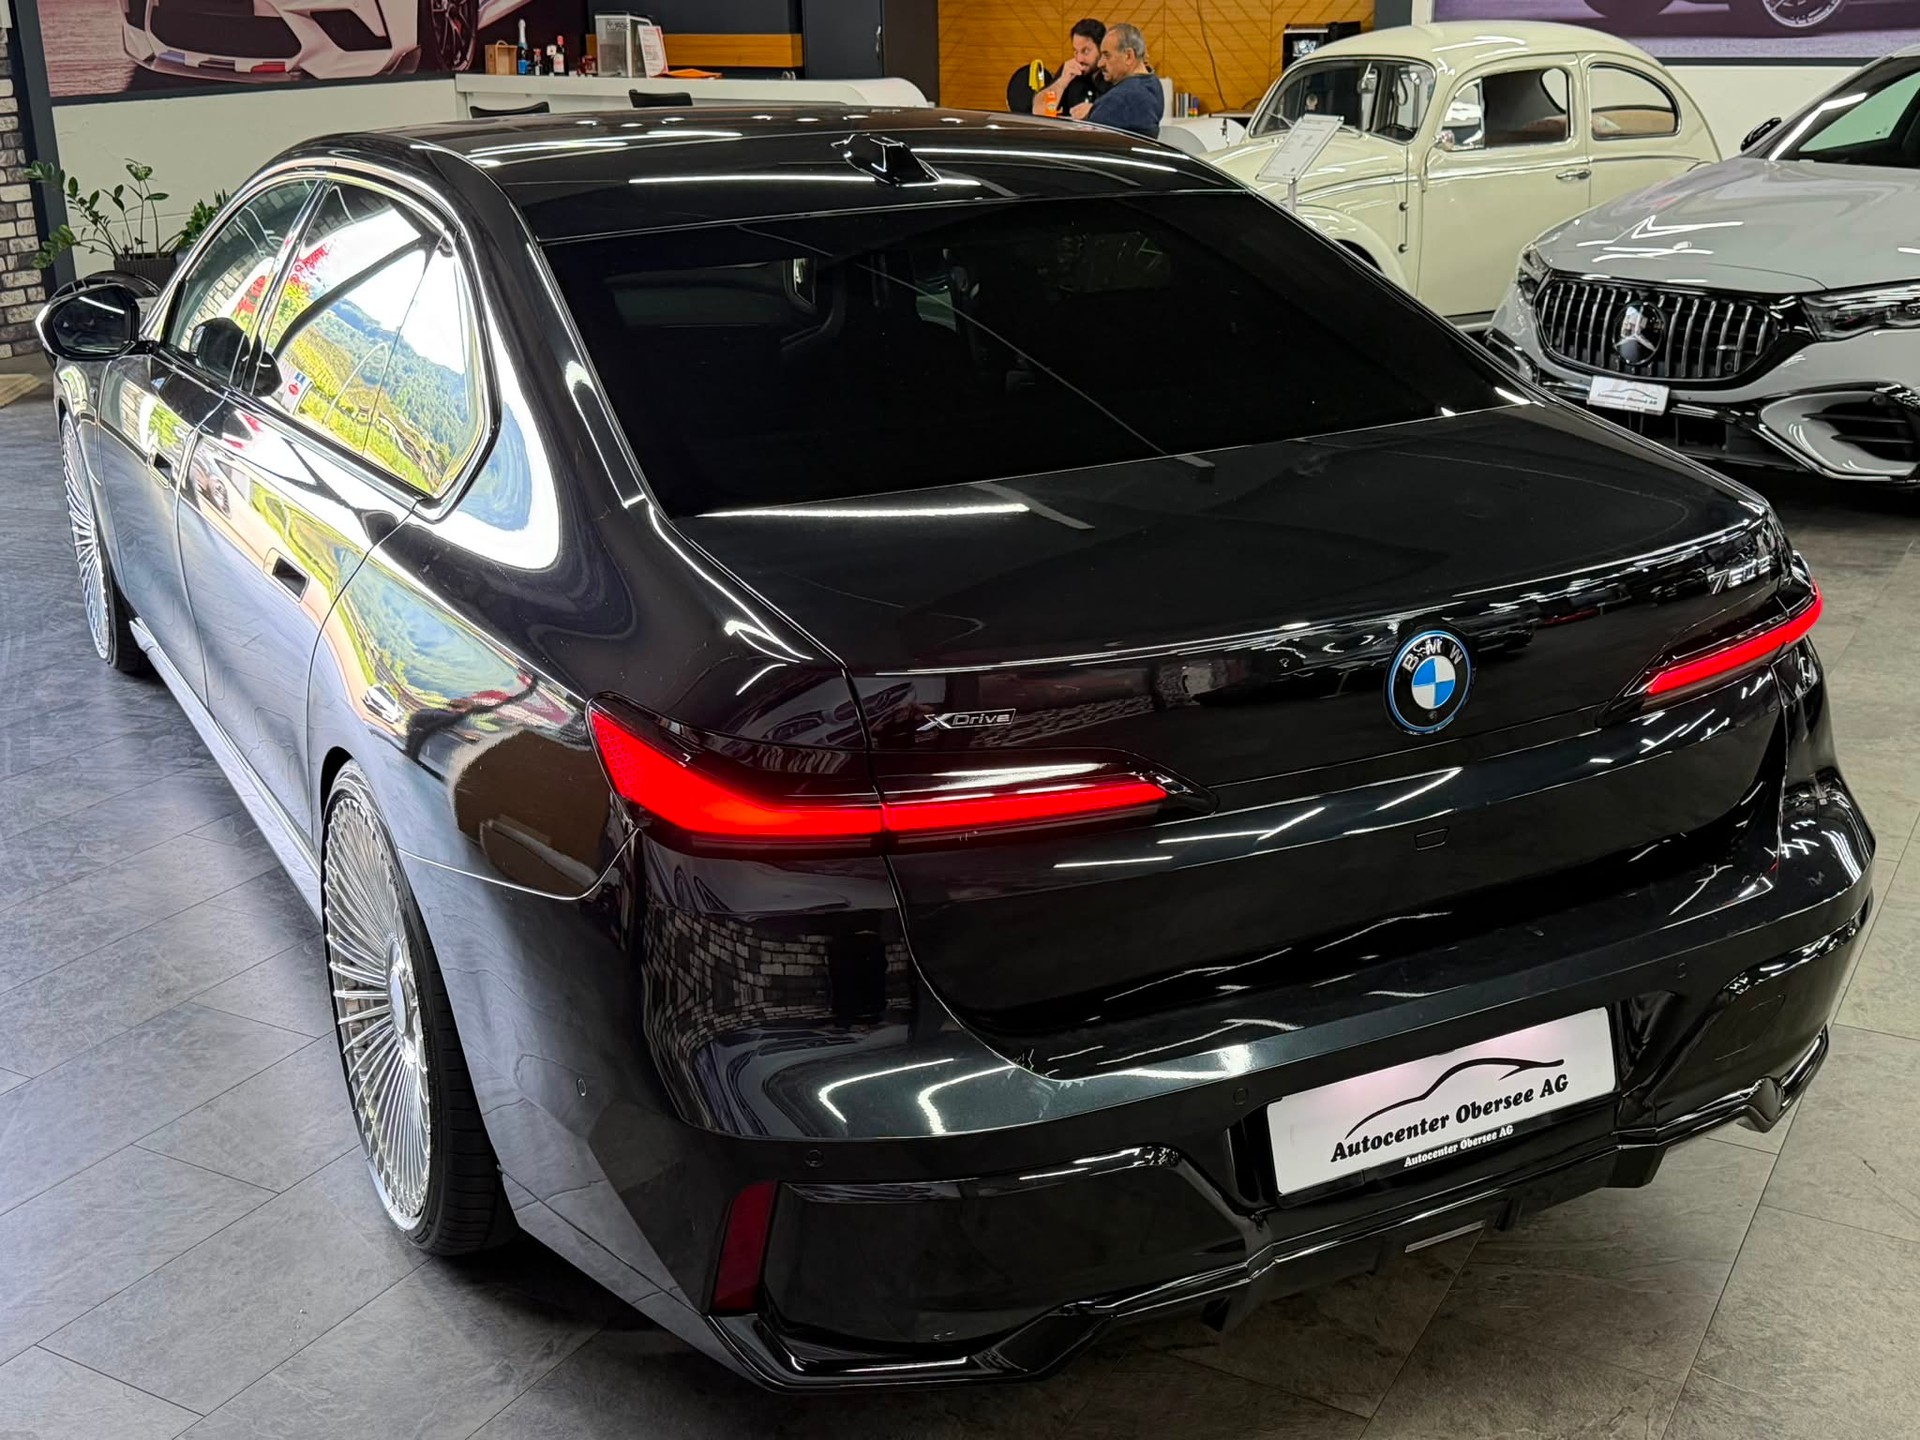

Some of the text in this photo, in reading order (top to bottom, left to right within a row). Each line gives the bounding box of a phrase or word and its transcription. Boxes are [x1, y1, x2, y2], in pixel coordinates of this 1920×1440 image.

[1401, 638, 1463, 673] BMW
[1330, 1074, 1569, 1162] Autocenter Obersee AG
[1403, 1125, 1514, 1168] Autocenter Obersee AG
